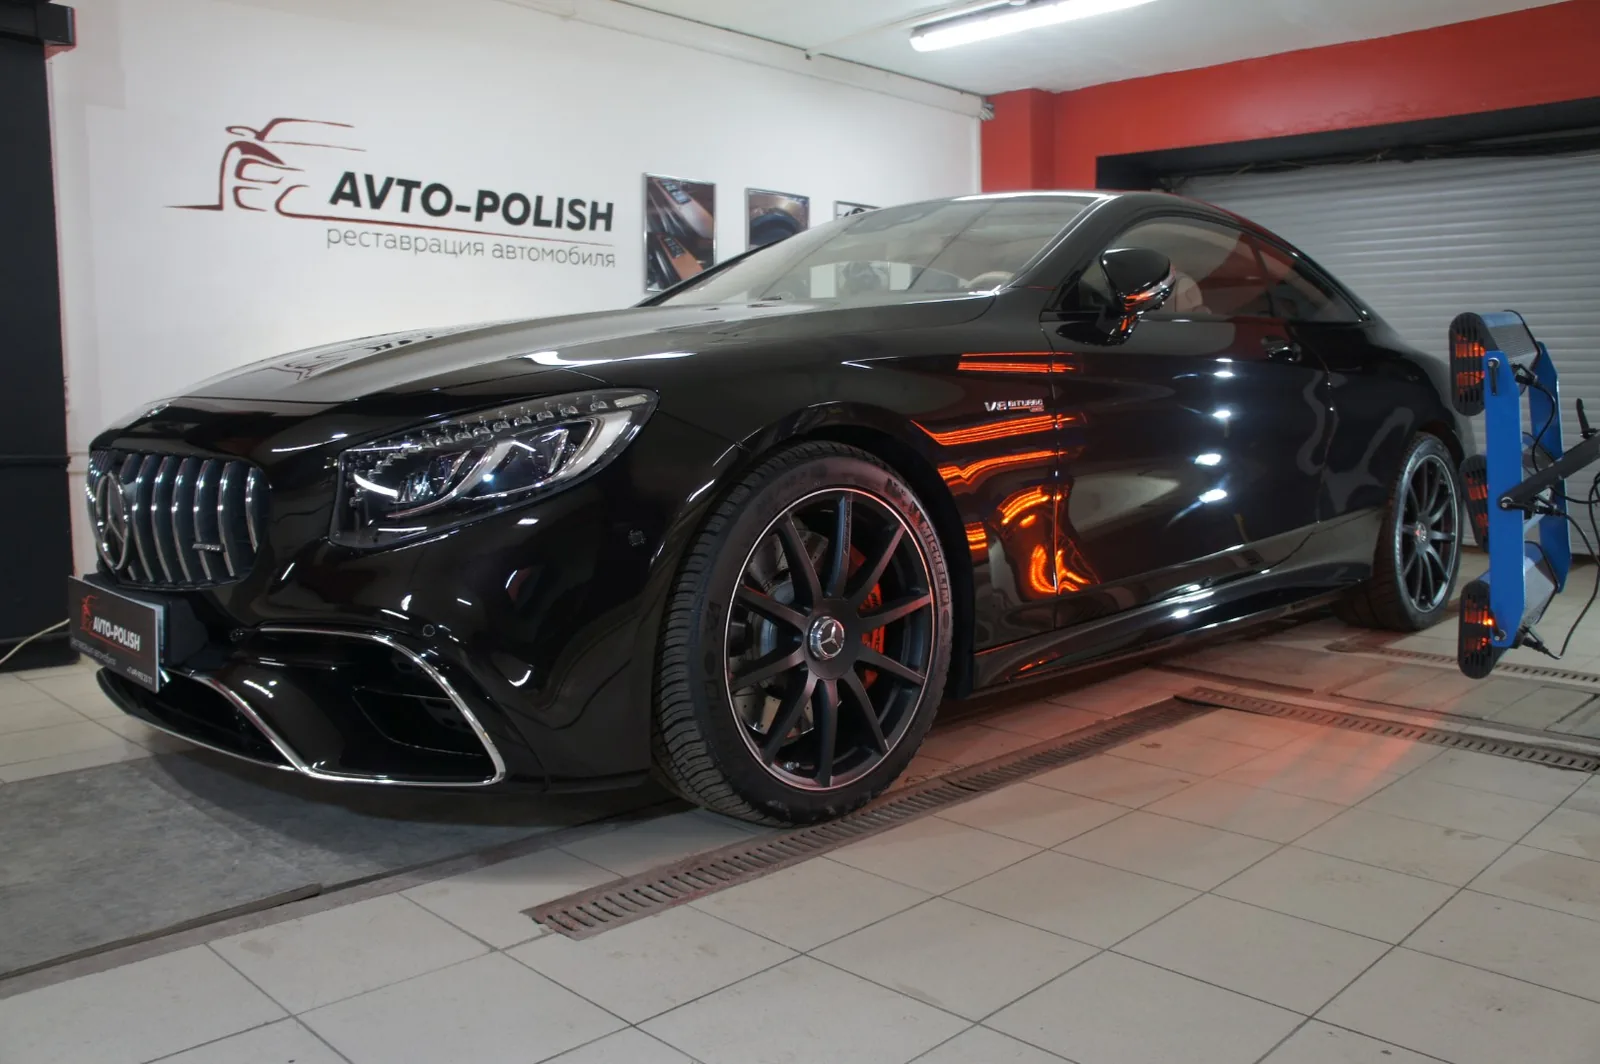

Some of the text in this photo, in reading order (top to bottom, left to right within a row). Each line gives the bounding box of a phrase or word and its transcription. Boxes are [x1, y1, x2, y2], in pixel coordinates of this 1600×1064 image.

[329, 171, 614, 232] AVTO-POLISH
[326, 227, 616, 268] реставрация автомобиля
[920, 522, 949, 606] MICHELIN
[93, 616, 140, 651] AVTO-POLISH
